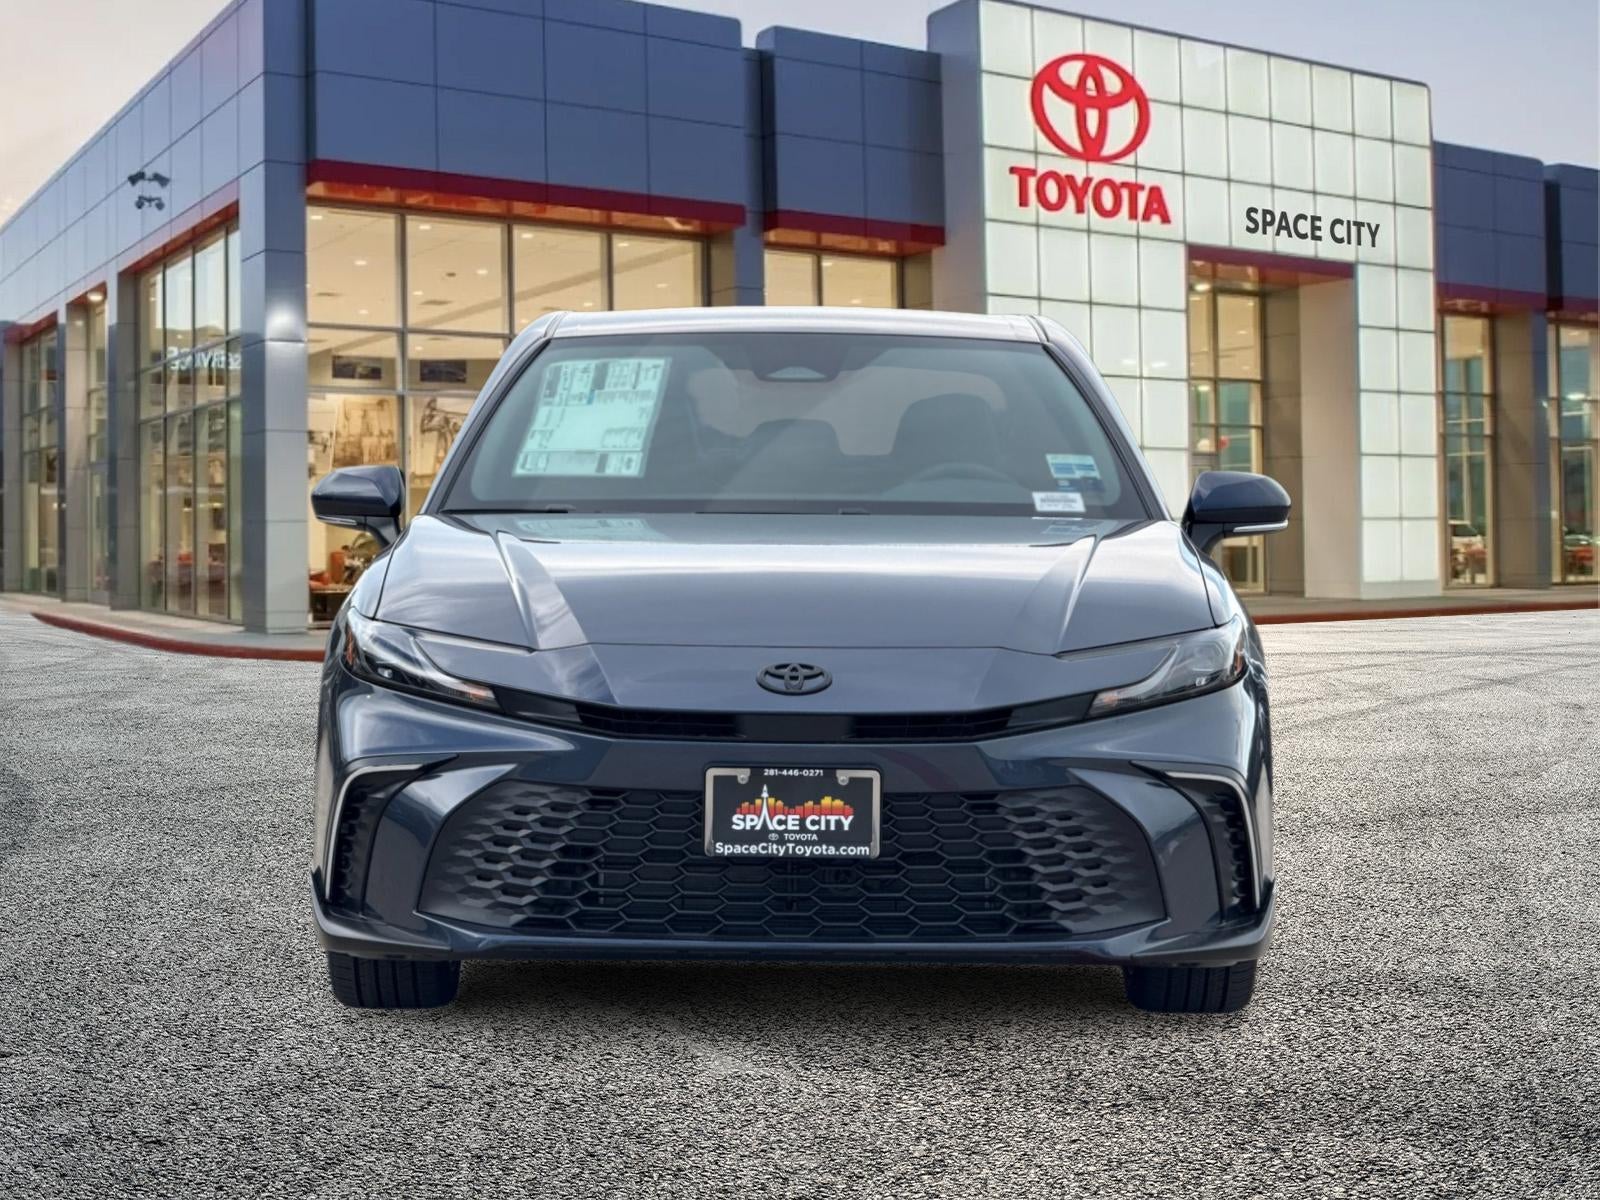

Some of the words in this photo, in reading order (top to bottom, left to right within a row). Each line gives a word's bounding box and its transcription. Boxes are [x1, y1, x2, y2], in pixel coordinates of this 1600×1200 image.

[1009, 166, 1171, 224] TOYOTA
[1245, 207, 1322, 242] SPACE
[1329, 218, 1380, 248] CITY
[763, 768, 824, 777] 281-446-0271
[731, 814, 800, 831] SPACE
[805, 815, 854, 831] CITY
[783, 833, 818, 841] TOYOTA
[715, 842, 870, 857] SpaceCityToyota.com
